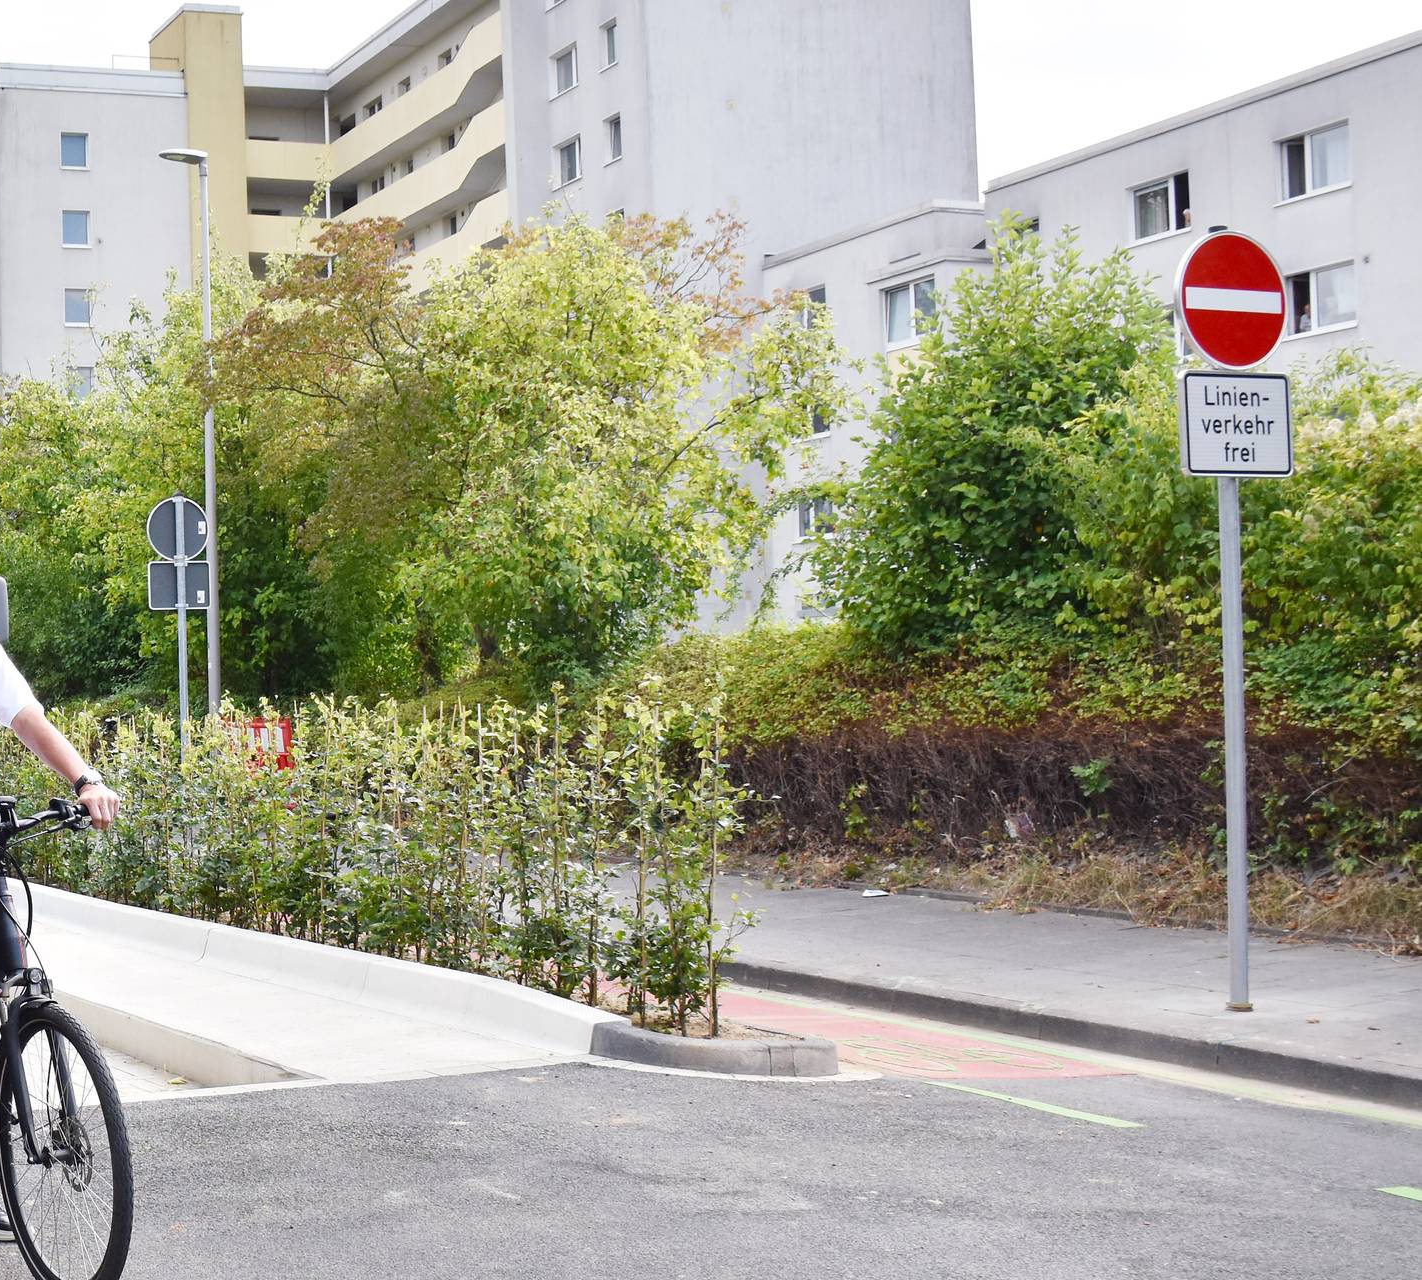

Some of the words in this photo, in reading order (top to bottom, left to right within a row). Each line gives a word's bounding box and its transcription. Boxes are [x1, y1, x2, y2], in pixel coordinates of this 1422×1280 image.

[1204, 385, 1270, 406] Linien-
[1202, 414, 1275, 435] verkehr
[1224, 442, 1256, 462] frei
